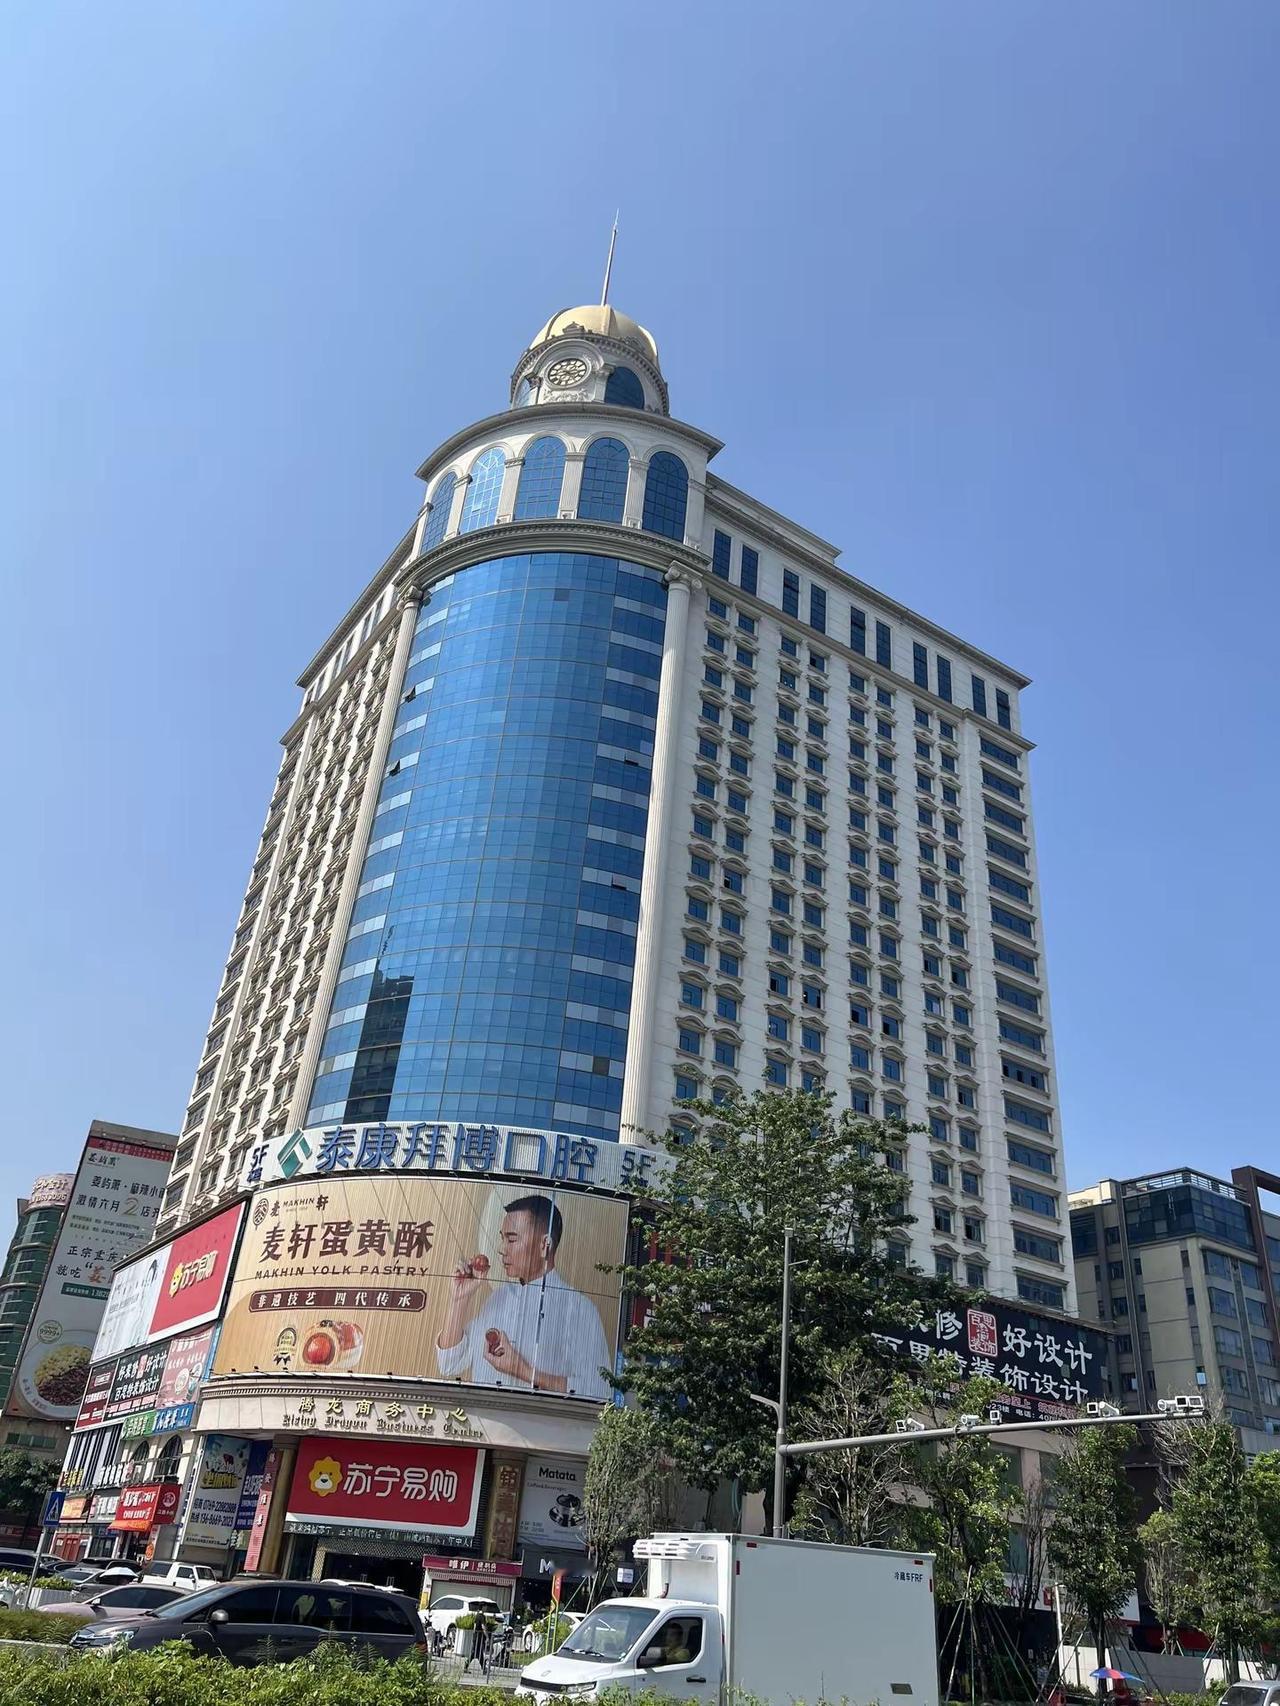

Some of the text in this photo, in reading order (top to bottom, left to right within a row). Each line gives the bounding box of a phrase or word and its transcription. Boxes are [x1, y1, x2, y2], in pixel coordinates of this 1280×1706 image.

[250, 1143, 270, 1169] 5F
[315, 1121, 598, 1184] 泰康拜博口腔
[622, 1150, 652, 1175] 5F
[282, 1197, 315, 1207] MAKHIN
[258, 1219, 435, 1263] 麦轩蛋黄酥
[254, 1265, 430, 1280] MAKHIN YOLK PASTRY
[257, 1291, 411, 1308] 非遗技艺 四代传承
[1002, 1323, 1093, 1376] 好设计
[298, 1396, 469, 1422] 腾龙商务中心
[282, 1414, 317, 1429] Rising
[324, 1415, 368, 1431] Dragon
[376, 1418, 434, 1434] Business
[342, 1461, 459, 1503] 苏宁易购
[538, 1466, 577, 1481] Matata
